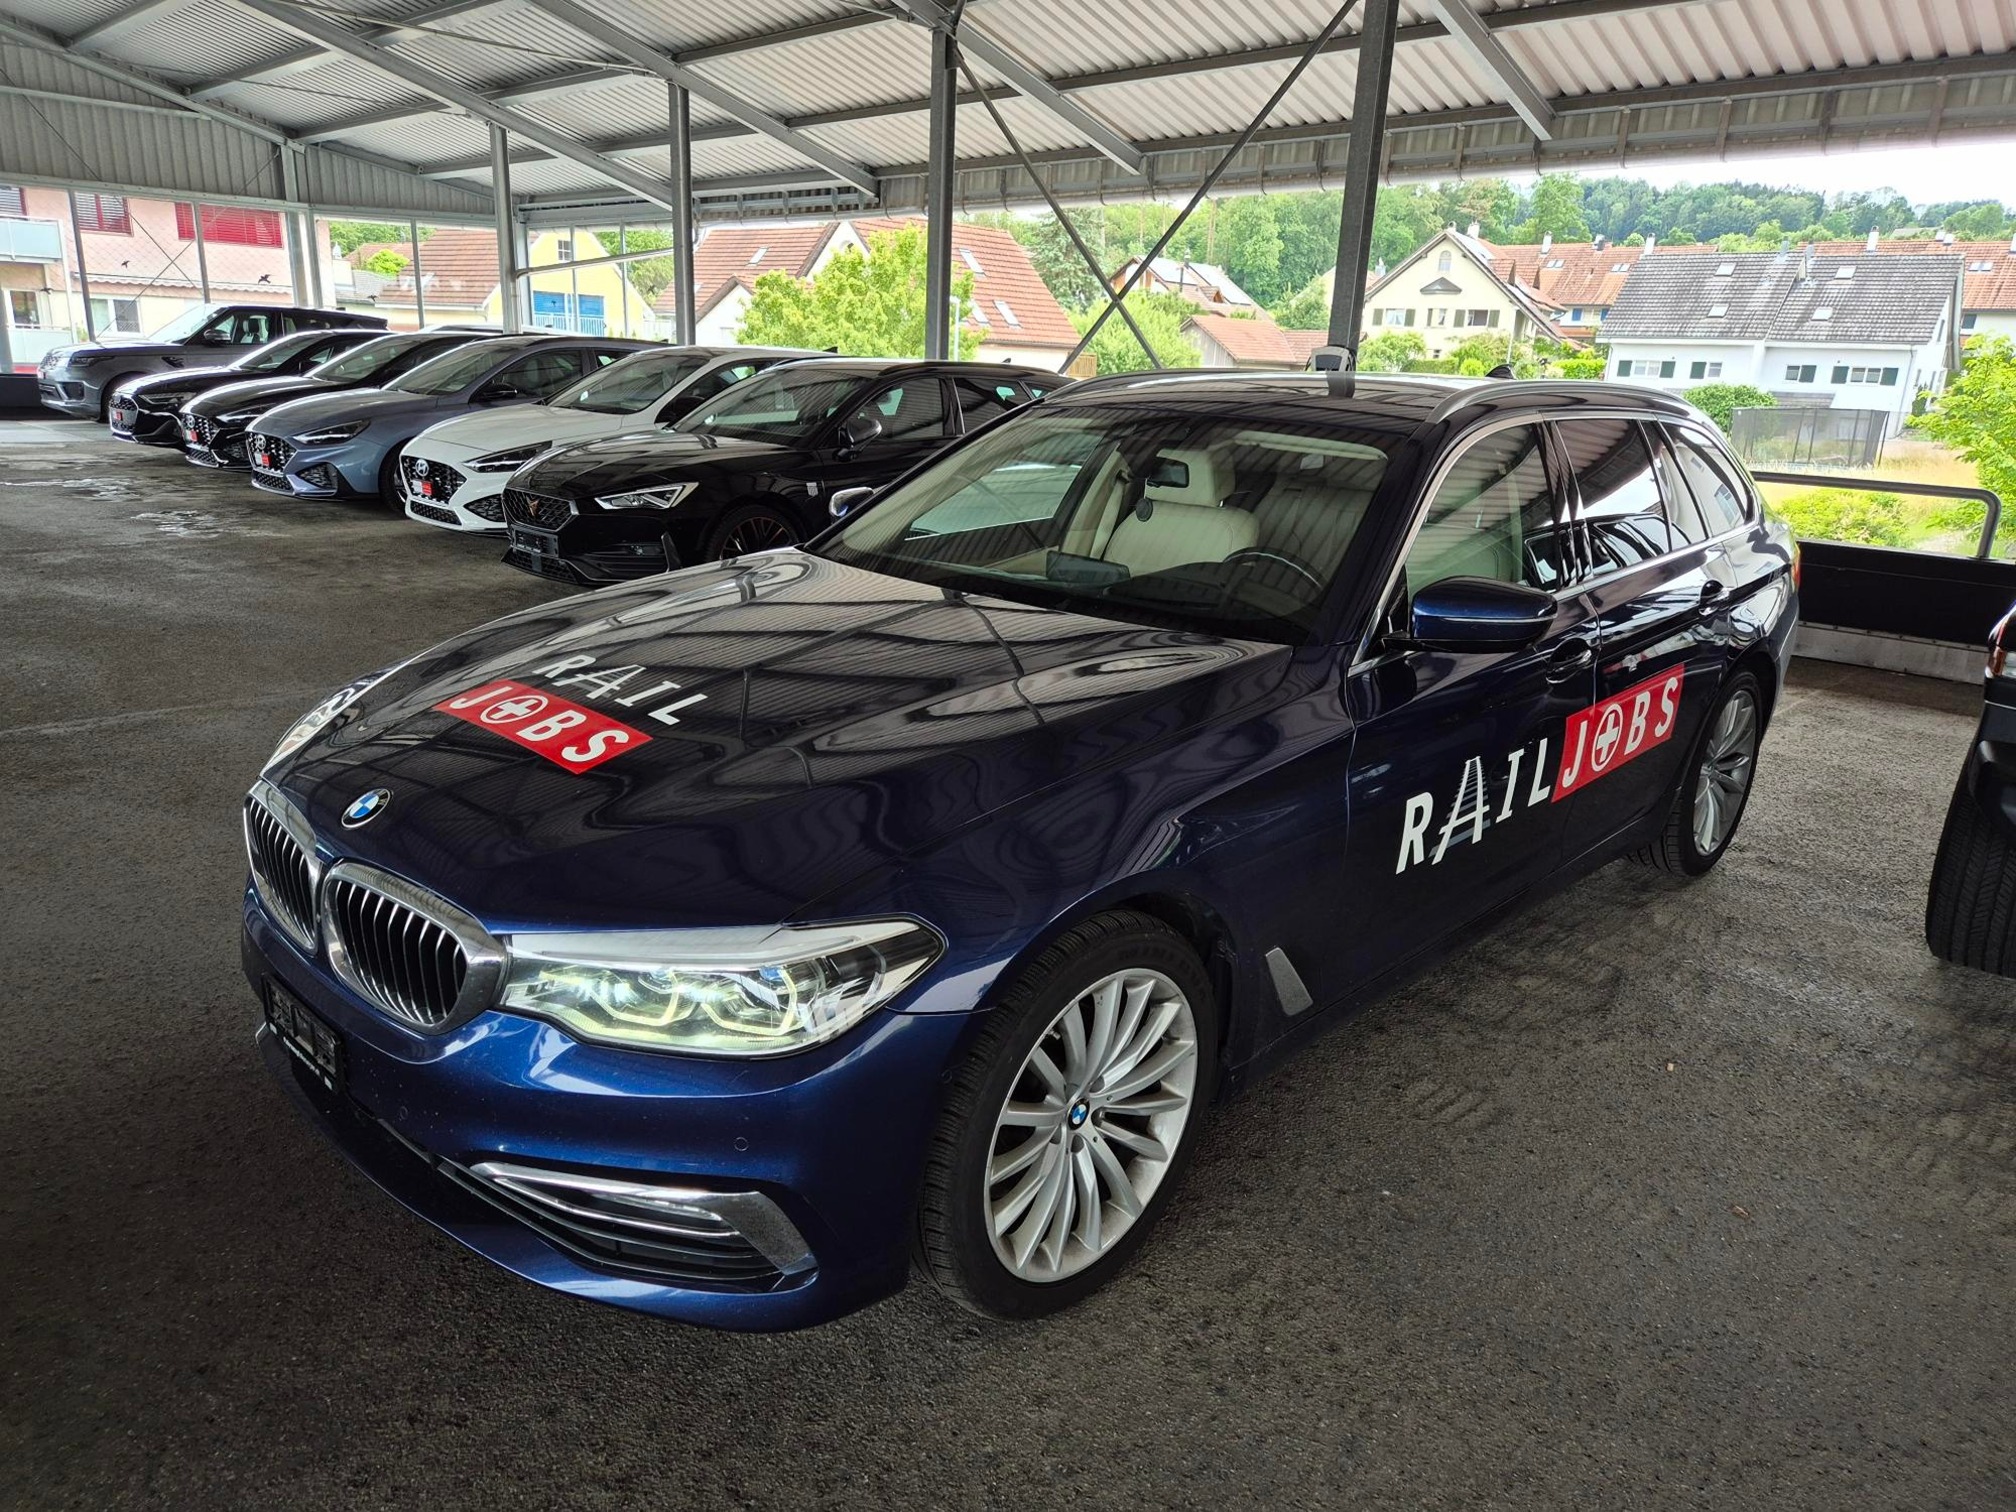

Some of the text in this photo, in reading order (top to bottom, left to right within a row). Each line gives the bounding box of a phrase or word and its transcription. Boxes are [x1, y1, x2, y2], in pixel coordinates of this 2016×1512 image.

[449, 686, 630, 762] JOBS
[532, 655, 708, 725] RAIL
[1395, 676, 1679, 874] RAIL JOBS
